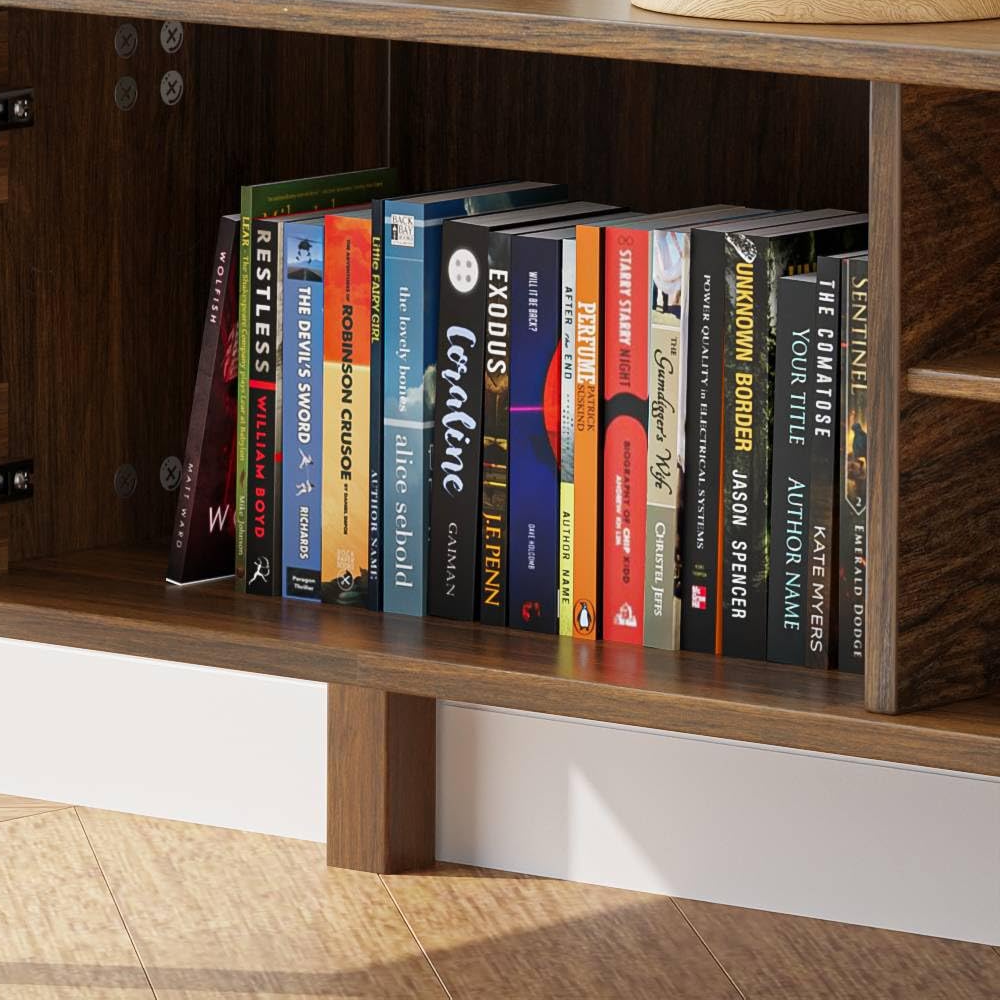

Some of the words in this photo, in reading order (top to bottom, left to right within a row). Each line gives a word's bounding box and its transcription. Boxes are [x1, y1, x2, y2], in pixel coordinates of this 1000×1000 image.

[242, 215, 250, 247] LEAR
[392, 215, 413, 225] BACK
[371, 236, 380, 270] Little
[528, 271, 538, 288] WILL
[619, 249, 632, 296] STARRY
[209, 251, 227, 324] WOLFISH
[255, 229, 272, 374] RESTLESS
[298, 286, 311, 314] THE
[371, 273, 380, 314] FAIRY
[399, 286, 411, 312] the
[528, 297, 538, 306] BE
[564, 286, 573, 324] AFTER
[701, 274, 711, 321] POWER
[736, 261, 753, 362] UNKNOWN
[818, 279, 836, 316] THE
[371, 315, 380, 344] GIRL
[396, 316, 411, 360] lovely
[486, 268, 508, 375] EXODUS
[528, 308, 538, 332] BACK?
[577, 301, 596, 385] PERFUME
[619, 299, 632, 346] STARRY
[670, 337, 678, 356] THE
[850, 276, 868, 395] SENTINEL
[297, 320, 311, 378] DEVIL'S
[341, 304, 353, 403] ROBINSON
[564, 354, 573, 380] END
[619, 347, 631, 388] NIGHT
[699, 325, 710, 386] QUALITY
[790, 327, 811, 384] YOUR
[399, 365, 411, 412] bones
[587, 385, 596, 431] PATRICK
[652, 348, 675, 443] Gumdigger's
[814, 328, 834, 438] COMATOSE
[255, 395, 268, 480] WILLIAM
[297, 383, 311, 444] SWORD
[441, 325, 477, 498] Coraline
[734, 372, 753, 452] BORDER
[788, 391, 806, 445] TITLE
[340, 408, 352, 480] CRUSOE
[395, 434, 413, 494] alice
[651, 448, 672, 496] Wife
[697, 403, 707, 486] ELECTRICAL
[183, 463, 194, 499] MATT
[370, 469, 378, 531] AUTHOR
[623, 440, 631, 505] BIOGRAPHY
[731, 469, 747, 526] JASON
[176, 508, 187, 549] WARD
[254, 488, 266, 539] BOYD
[299, 505, 309, 560] RICHARDS
[482, 512, 502, 539] J.F.
[563, 511, 571, 560] AUTHOR
[696, 488, 706, 550] SYSTEMS
[784, 476, 805, 564] AUTHOR
[395, 502, 413, 588] sebold
[446, 522, 458, 597] GAIMAN
[654, 521, 666, 584] CHRISTEL
[812, 525, 826, 577] KATE
[853, 524, 865, 597] EMERALD
[483, 543, 502, 606] PENN
[562, 569, 571, 604] NAME
[652, 587, 665, 616] JEFFS
[731, 540, 747, 619] SPENCER
[783, 571, 800, 630] NAME
[810, 583, 824, 653] MYERS
[853, 603, 864, 659] DODGE
